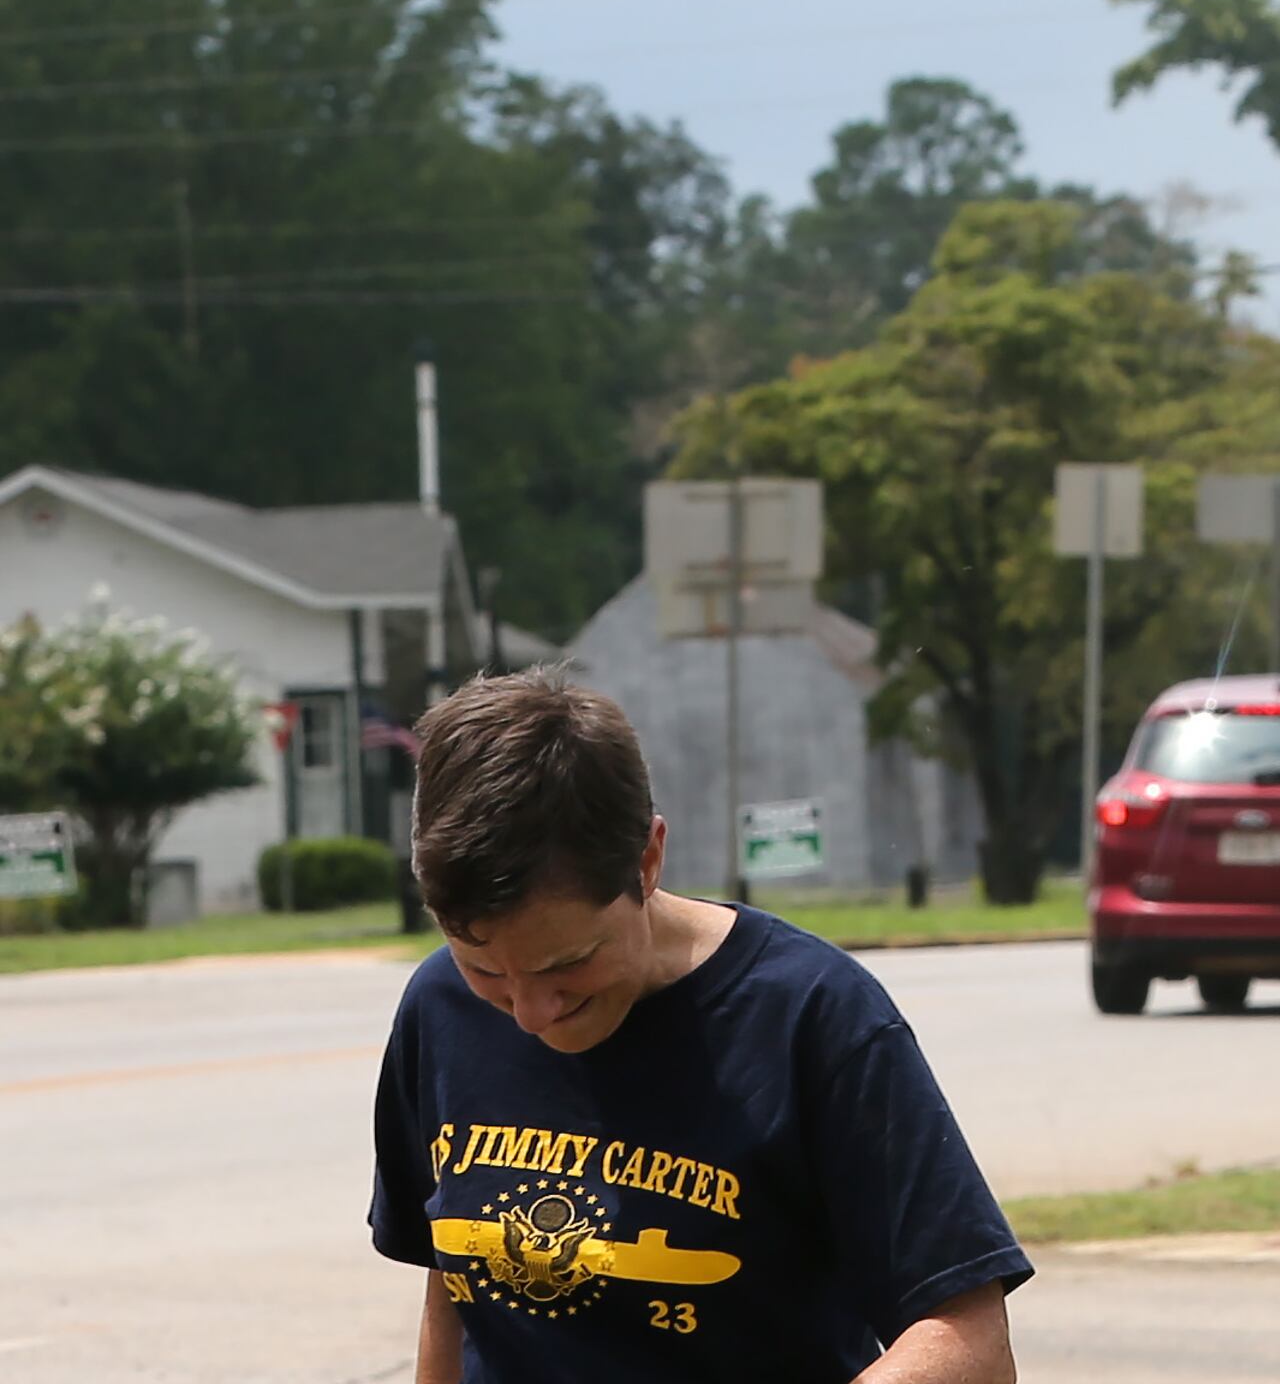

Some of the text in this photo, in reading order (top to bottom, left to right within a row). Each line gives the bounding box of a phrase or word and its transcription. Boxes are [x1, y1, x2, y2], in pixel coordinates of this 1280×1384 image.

[453, 1124, 598, 1177] JIMMY
[602, 1140, 741, 1220] CARTER
[648, 1299, 698, 1334] 23
